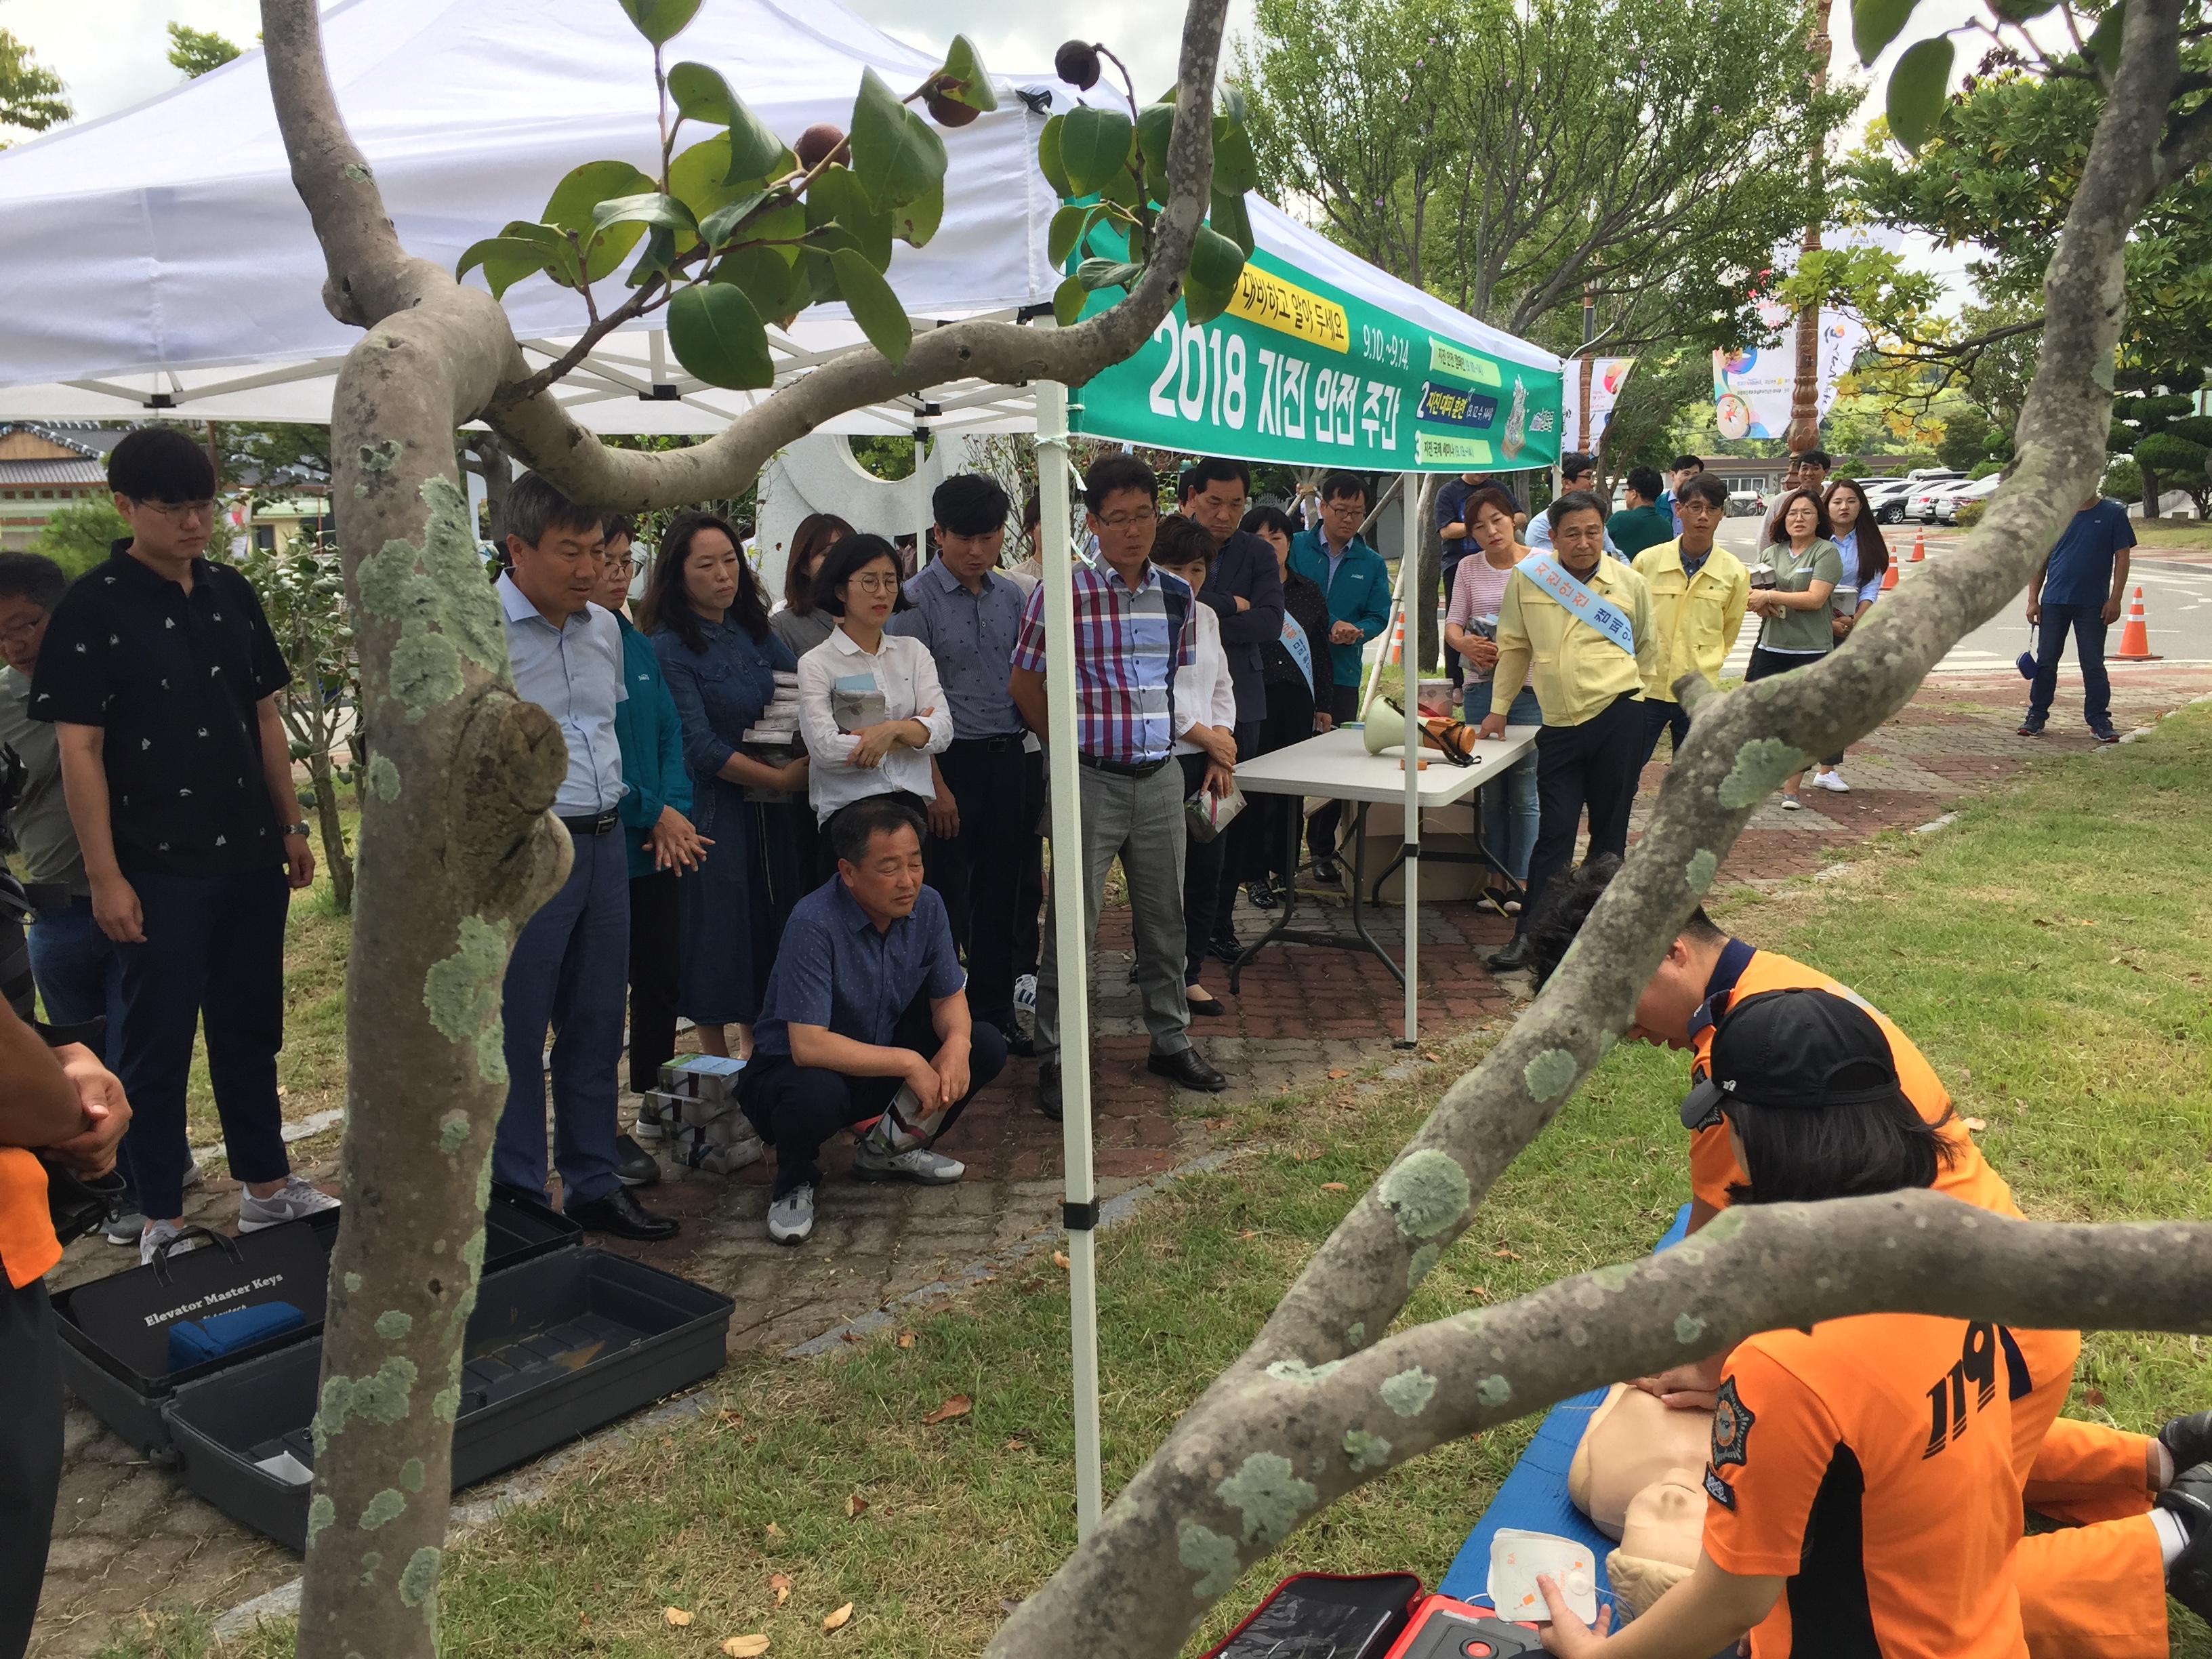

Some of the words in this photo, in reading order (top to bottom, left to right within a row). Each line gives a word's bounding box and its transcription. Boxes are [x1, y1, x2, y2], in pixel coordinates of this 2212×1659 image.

[1242, 271, 1290, 320] 대비하고
[1291, 293, 1313, 334] 알아
[1315, 303, 1345, 341] 두세요
[1149, 310, 1247, 430] 2018
[1257, 348, 1311, 440] 지진
[1315, 368, 1361, 447] 안전
[1361, 381, 1401, 451] 주간
[1416, 380, 1430, 419] 2
[1426, 391, 1443, 415] 지진
[1439, 394, 1456, 417] 대피
[1452, 396, 1469, 419] 훈련
[1414, 429, 1422, 466] 3
[1534, 561, 1590, 608] 지진안전
[1594, 607, 1632, 642] 캠페인
[144, 1299, 203, 1327] Elevator
[203, 1284, 251, 1306] Master
[251, 1273, 283, 1290] Keys
[1921, 1320, 1995, 1460] 119
